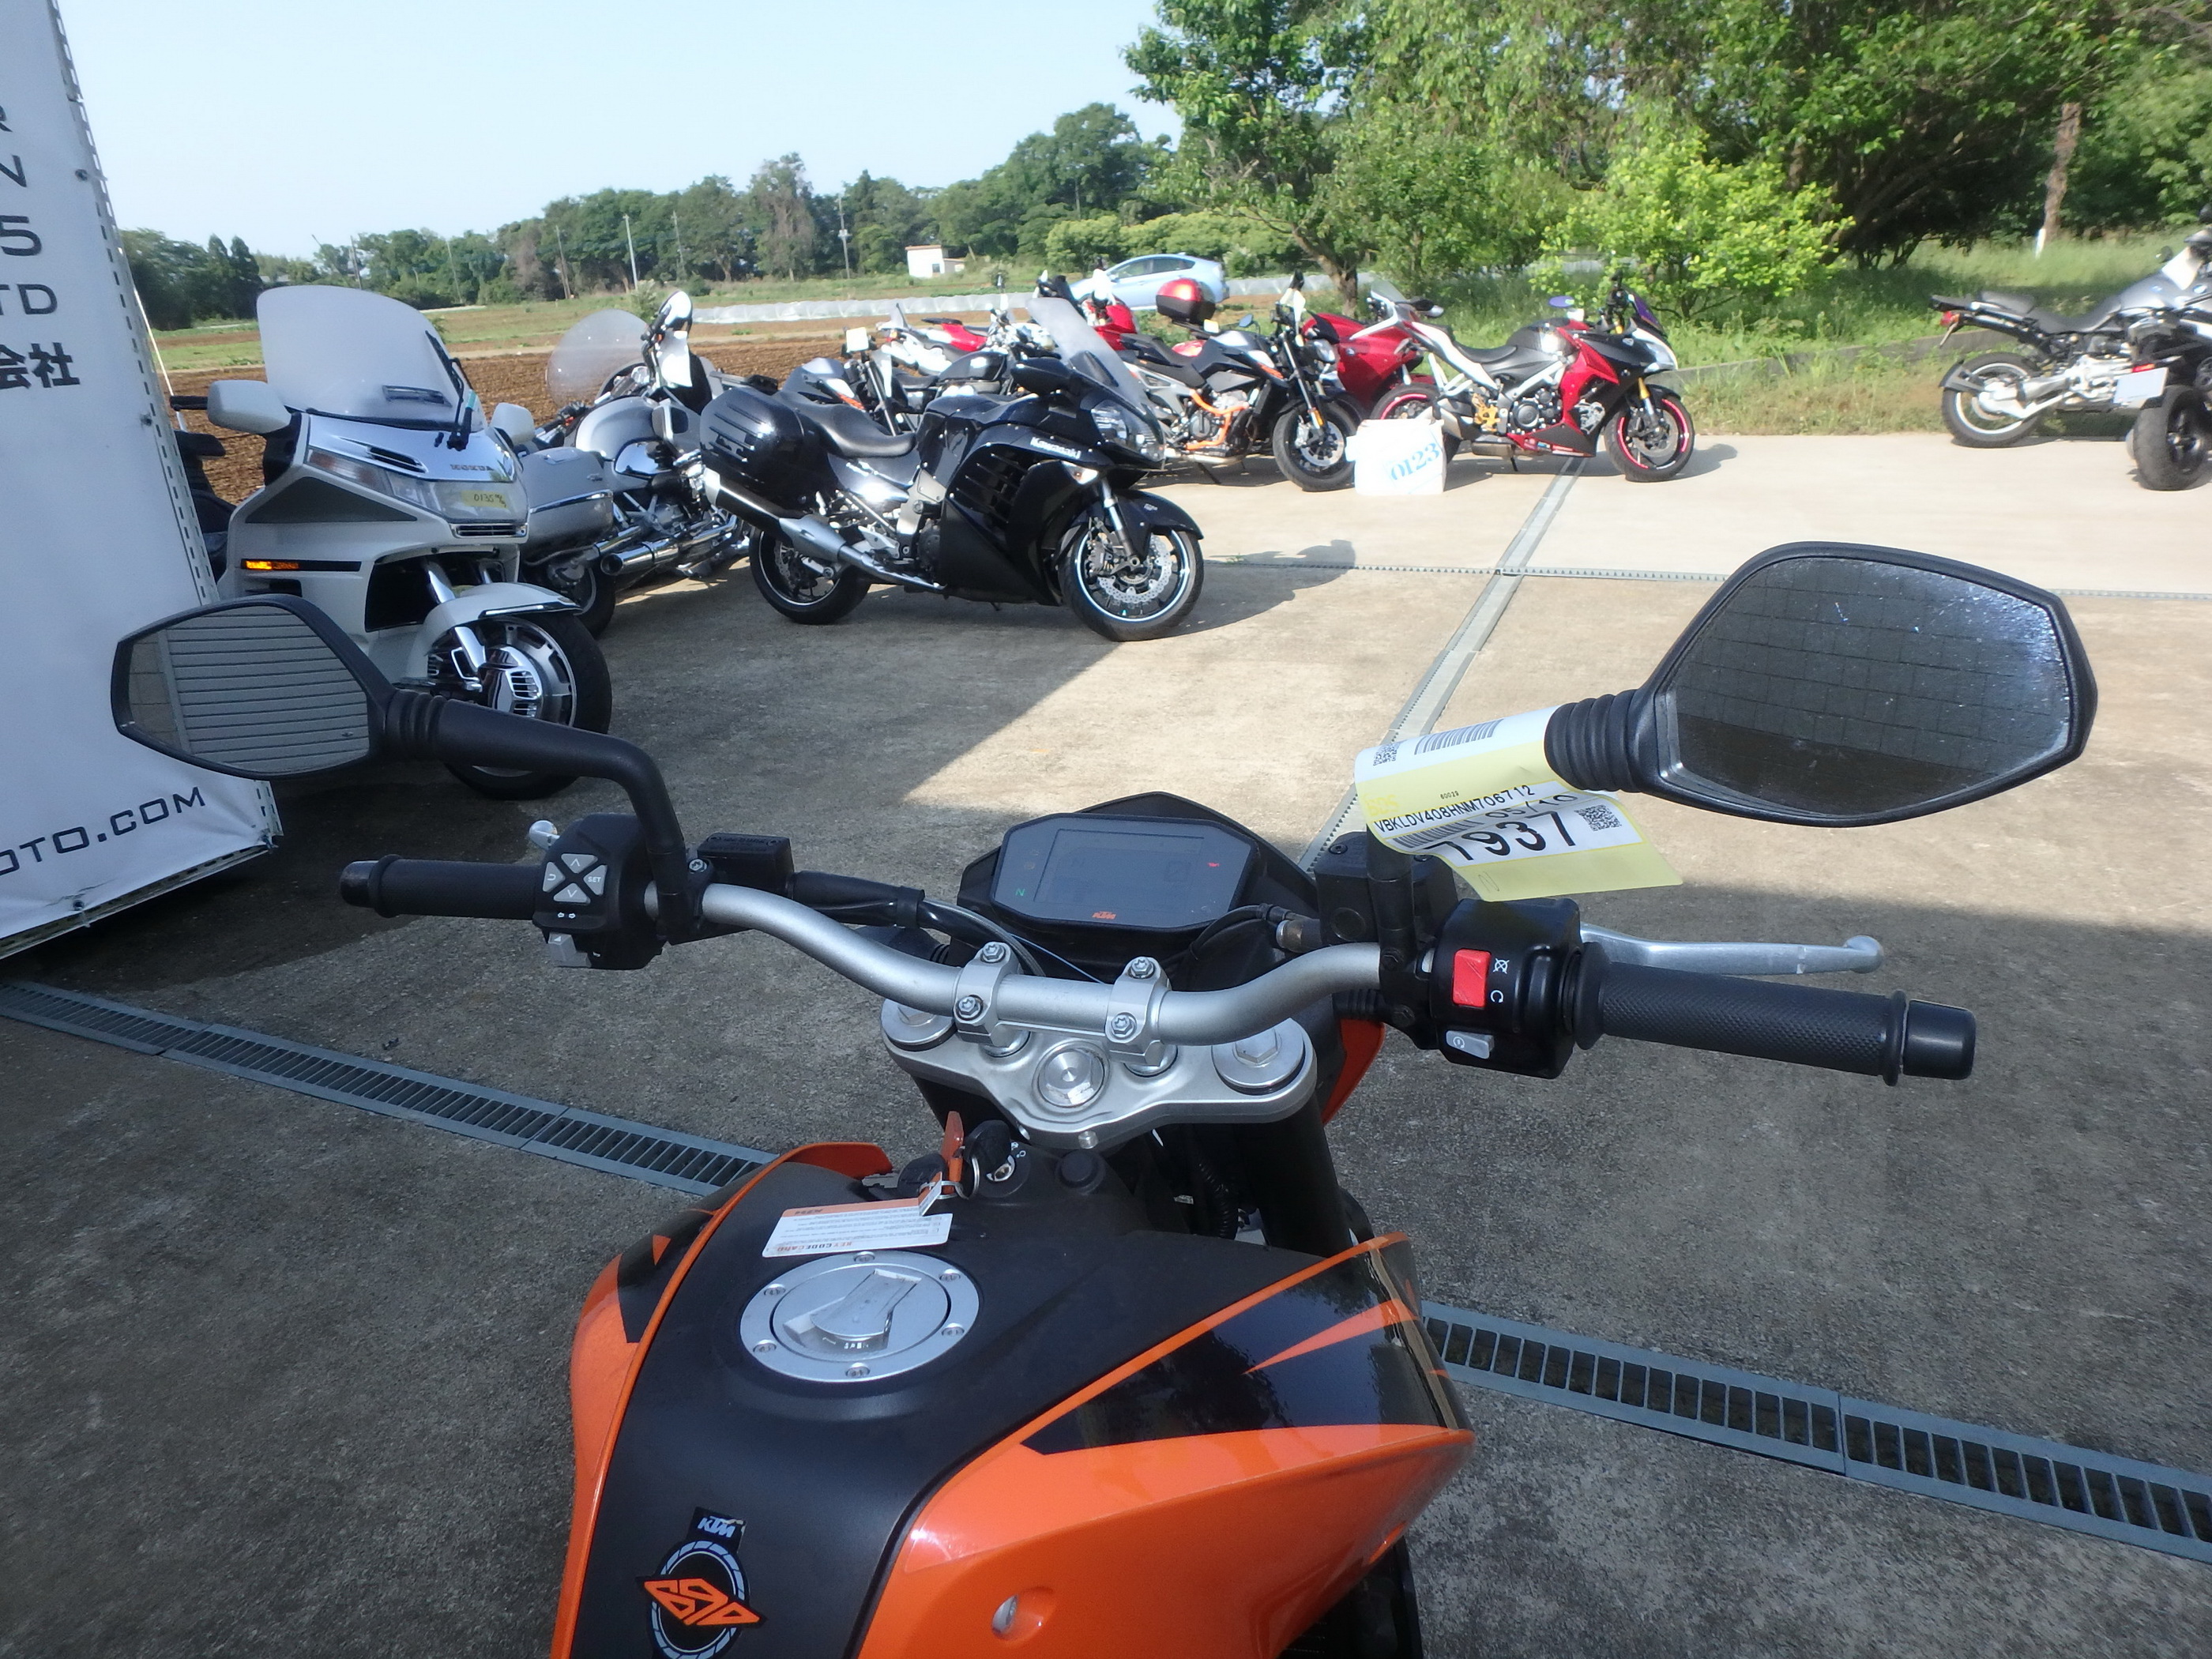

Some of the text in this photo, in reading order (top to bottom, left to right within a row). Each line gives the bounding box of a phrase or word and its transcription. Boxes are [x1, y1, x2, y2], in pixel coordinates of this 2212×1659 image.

[1030, 436, 1082, 460] Kawasaki
[1390, 442, 1440, 481] 0123
[1092, 911, 1116, 920] KTM
[697, 1515, 735, 1538] KTM
